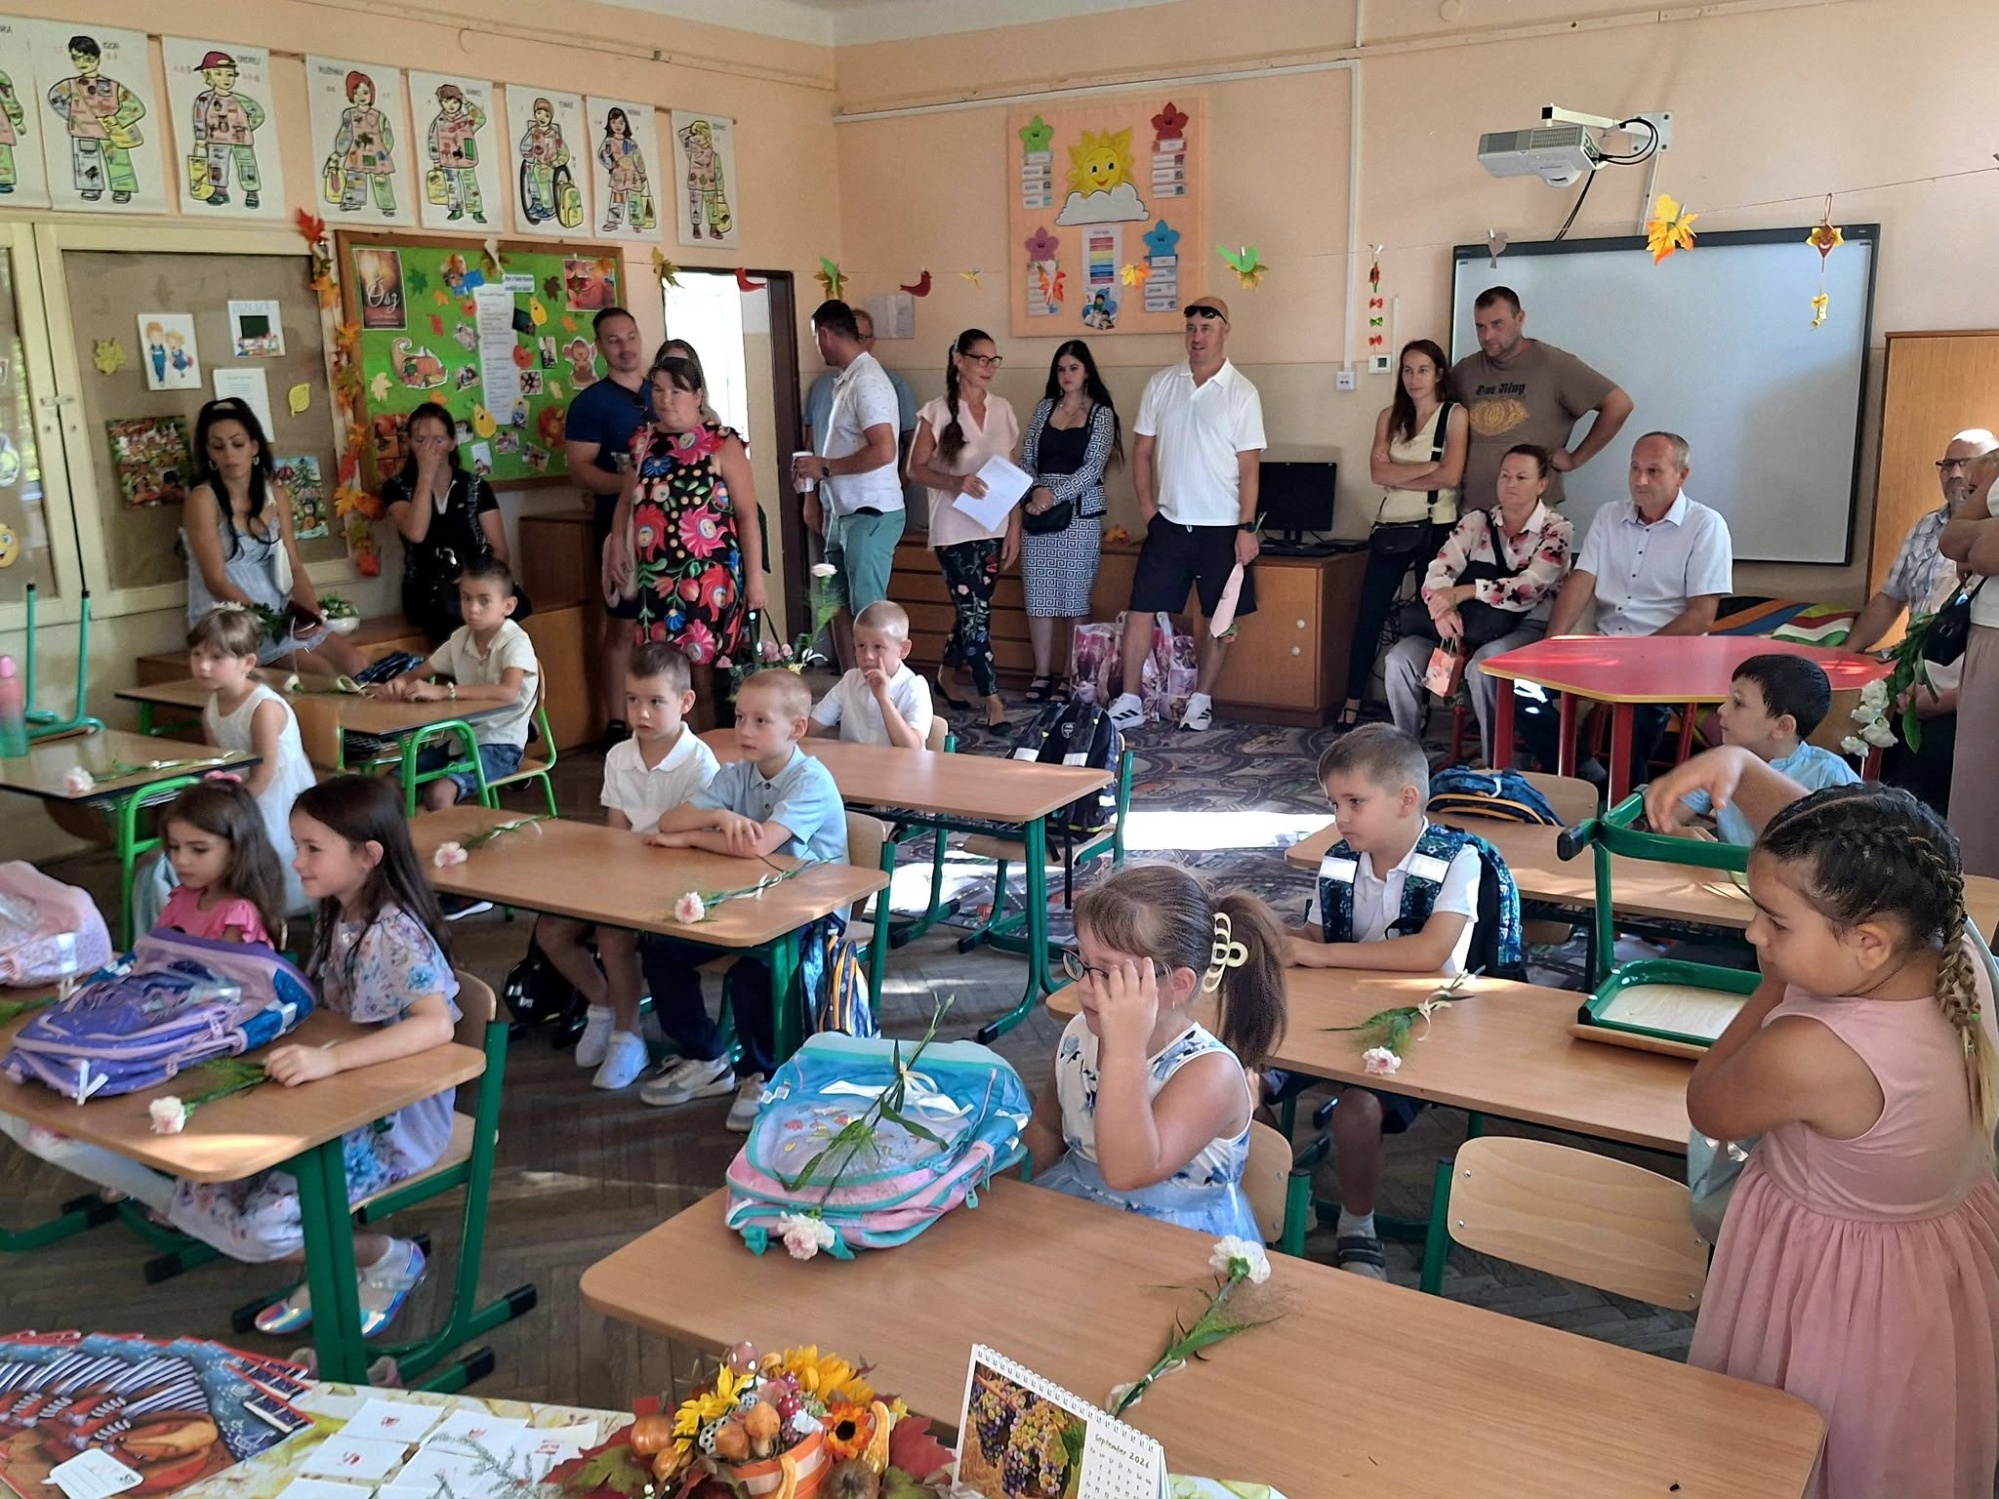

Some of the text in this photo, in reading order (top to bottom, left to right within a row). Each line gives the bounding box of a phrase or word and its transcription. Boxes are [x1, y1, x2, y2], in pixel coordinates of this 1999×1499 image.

[1499, 382, 1526, 395] Ring
[1095, 1434, 1150, 1468] September 2026
